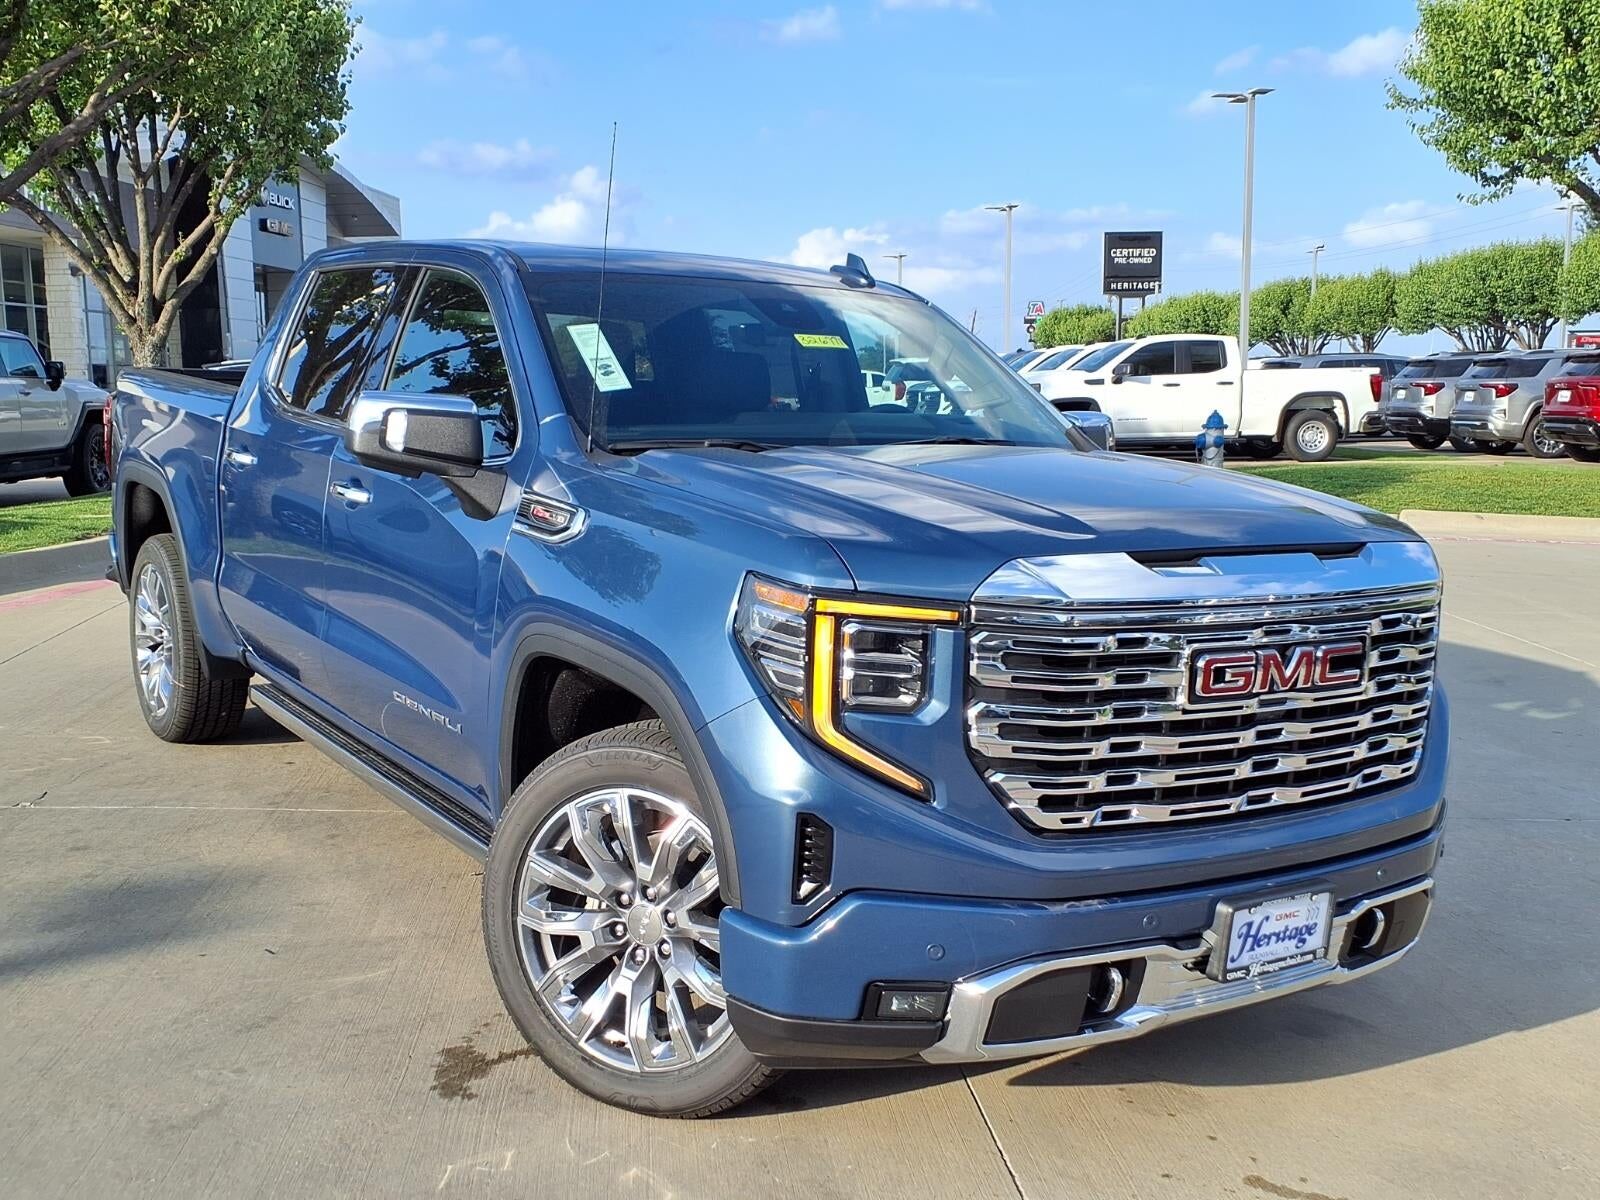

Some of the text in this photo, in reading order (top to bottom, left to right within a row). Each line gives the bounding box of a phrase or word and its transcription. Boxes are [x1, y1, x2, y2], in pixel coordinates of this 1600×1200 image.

[269, 192, 296, 210] BUICK
[1110, 248, 1157, 257] CERTIFIED
[1110, 282, 1156, 290] HERITAGE
[1195, 641, 1363, 697] GMC
[392, 690, 463, 735] DENALI
[1274, 910, 1300, 921] GMC
[1229, 915, 1319, 964] Heritage
